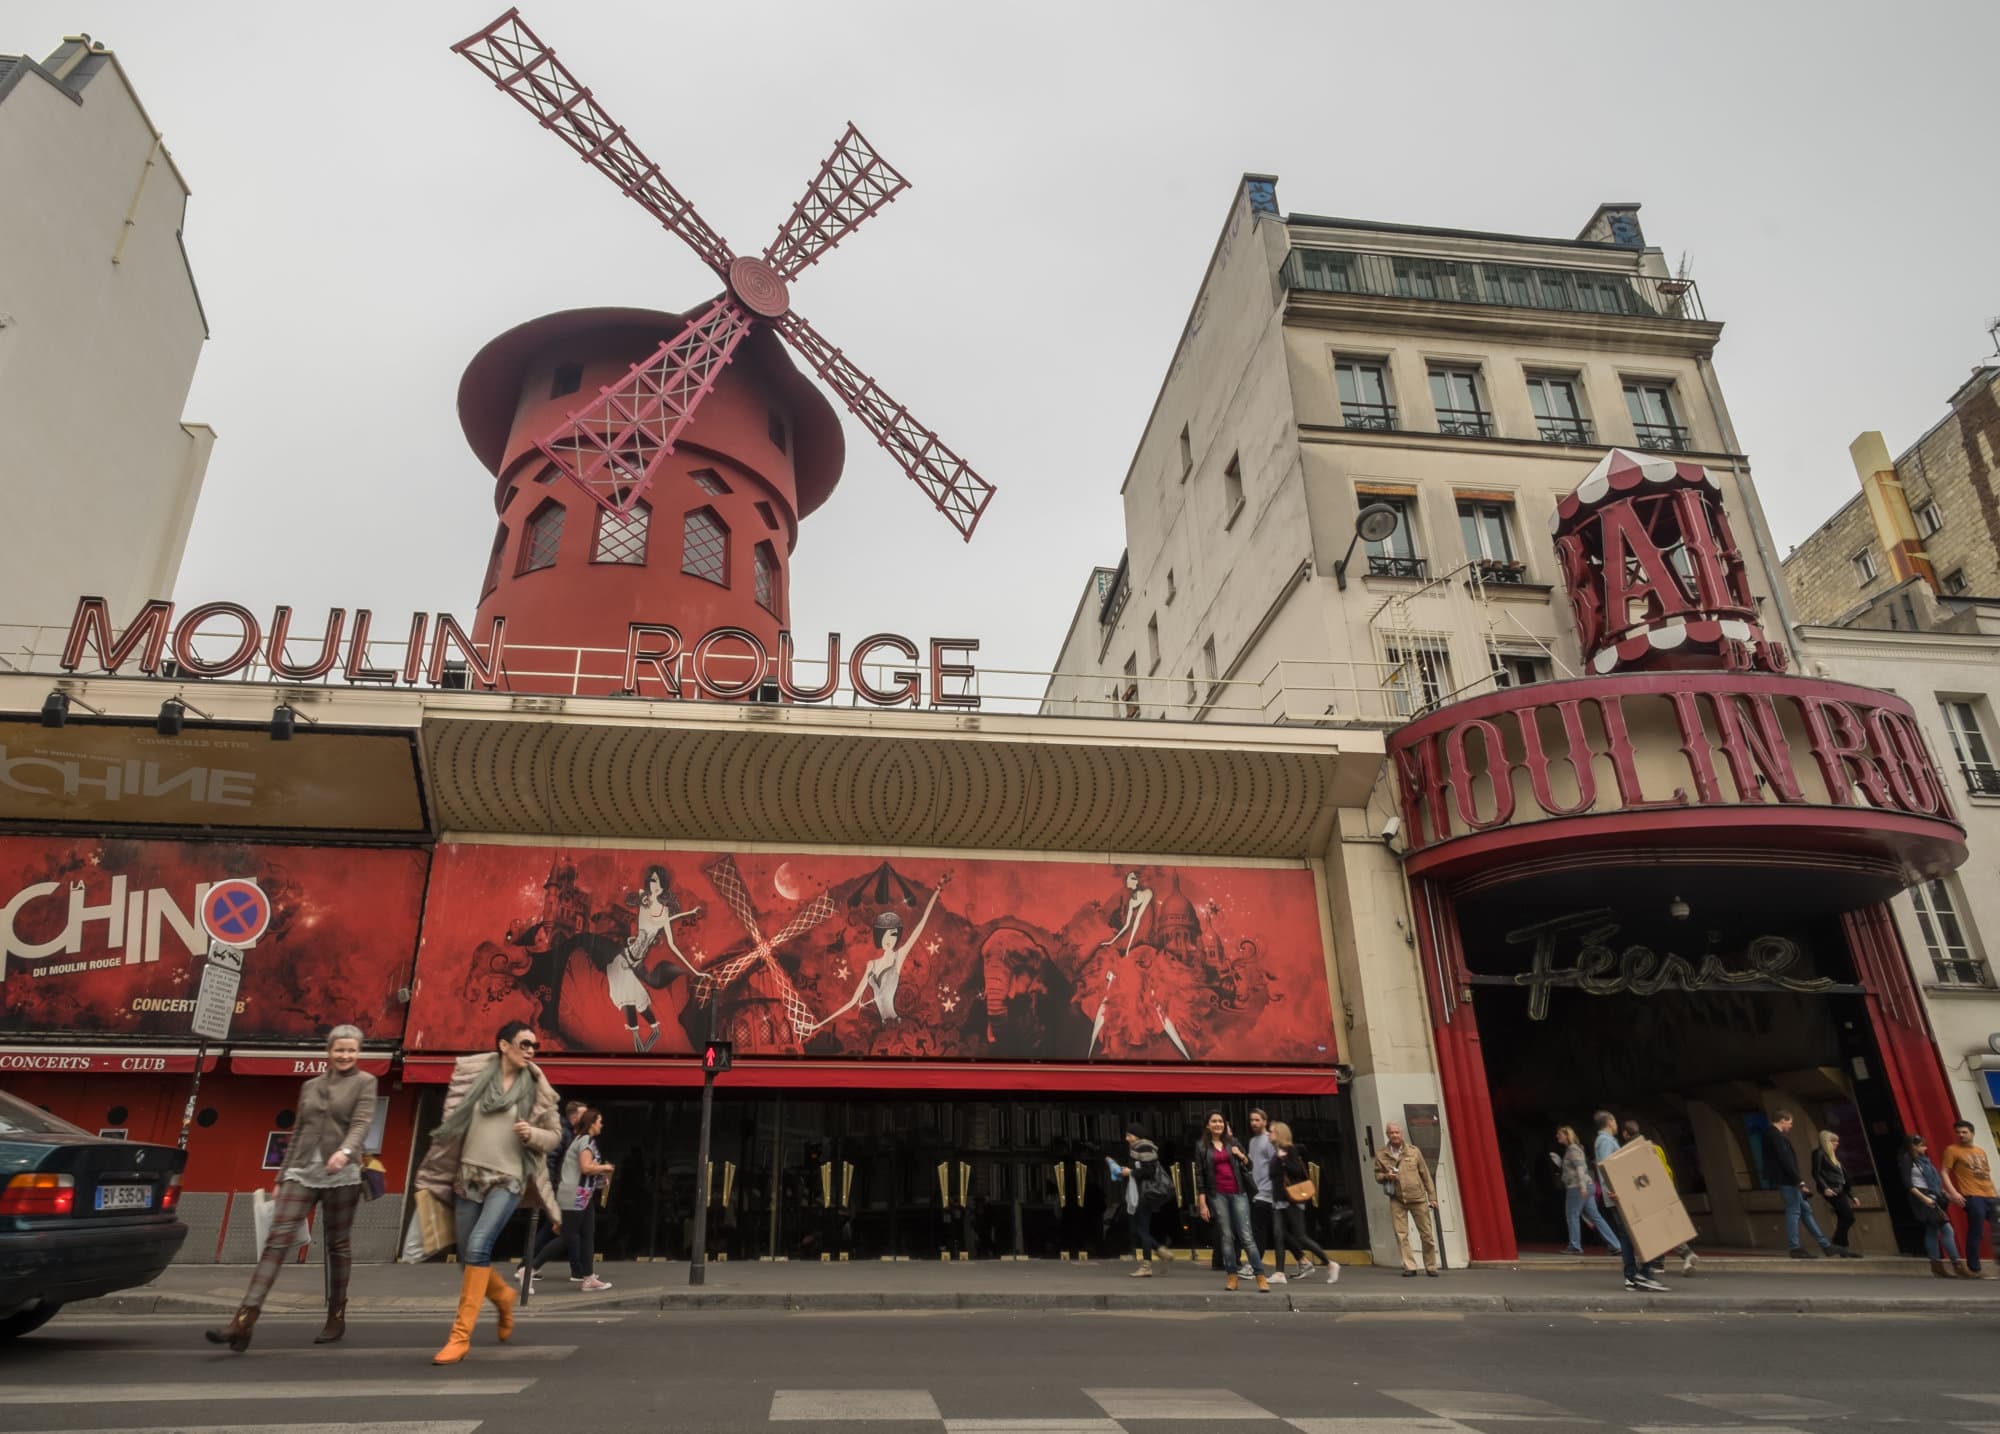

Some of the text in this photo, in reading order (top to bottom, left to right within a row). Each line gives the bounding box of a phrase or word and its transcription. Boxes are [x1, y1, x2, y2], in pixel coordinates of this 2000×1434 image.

[60, 595, 981, 707] MOULIN ROUGE
[1719, 638, 1790, 673] DU
[1395, 691, 1957, 850] MOULIN RO
[70, 879, 86, 890] LA
[33, 957, 121, 978] DU MOULIN ROUGE
[132, 998, 197, 1013] CONCERT
[0, 1055, 91, 1070] CONCERTS
[121, 1057, 166, 1071] CLUB
[293, 1060, 328, 1073] BAR
